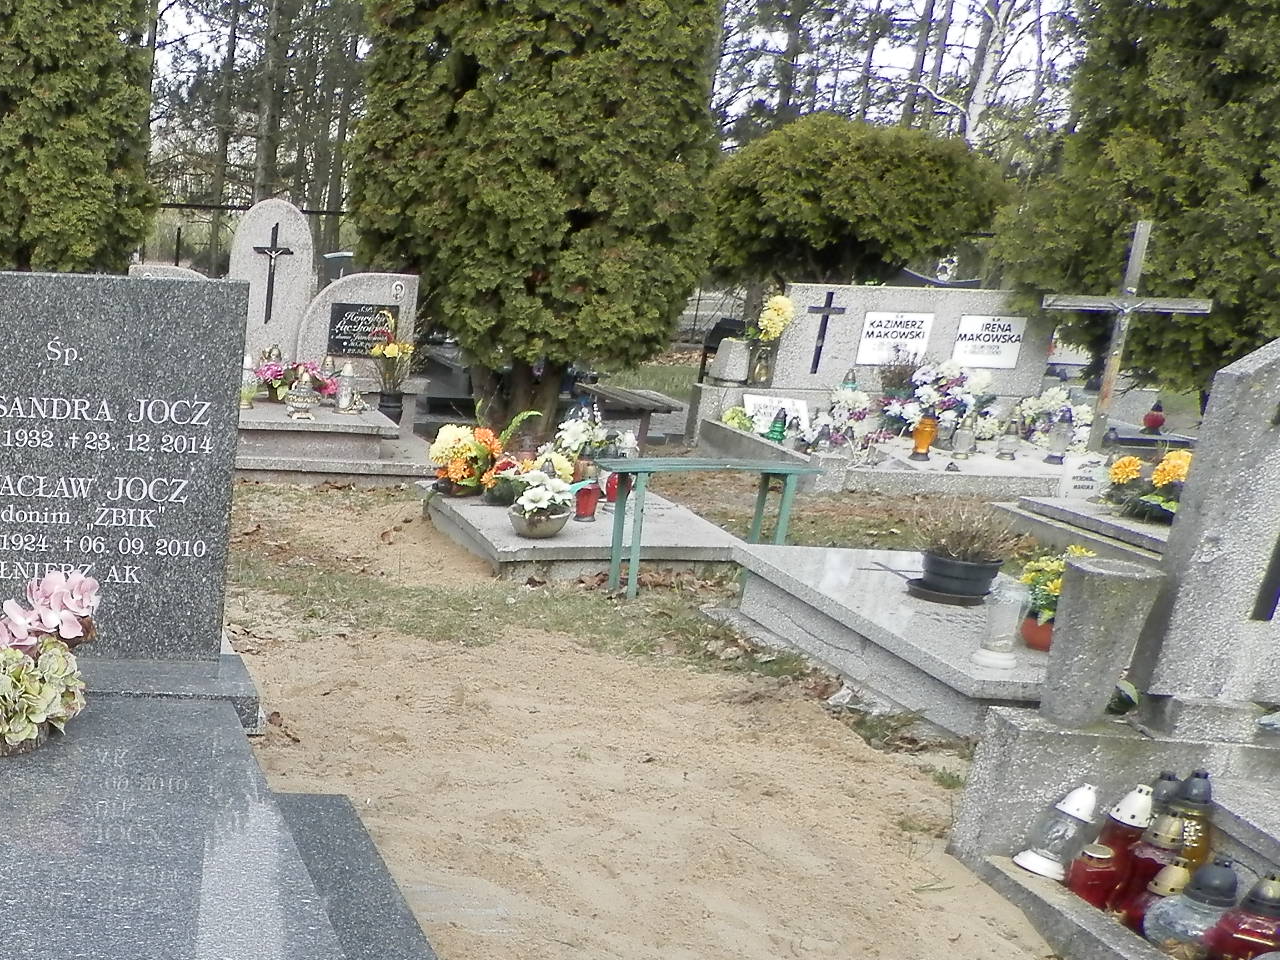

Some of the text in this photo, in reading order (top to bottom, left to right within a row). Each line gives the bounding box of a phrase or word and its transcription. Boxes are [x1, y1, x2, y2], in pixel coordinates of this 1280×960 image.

[869, 320, 925, 329] KAZIMIERZ
[981, 323, 1012, 333] IRENA
[864, 330, 926, 340] MAKOWSKI
[956, 333, 1022, 344] MAKOWSKA
[127, 398, 212, 427] JOCZ
[106, 476, 189, 505] JOCZ
[104, 565, 142, 585] AK
